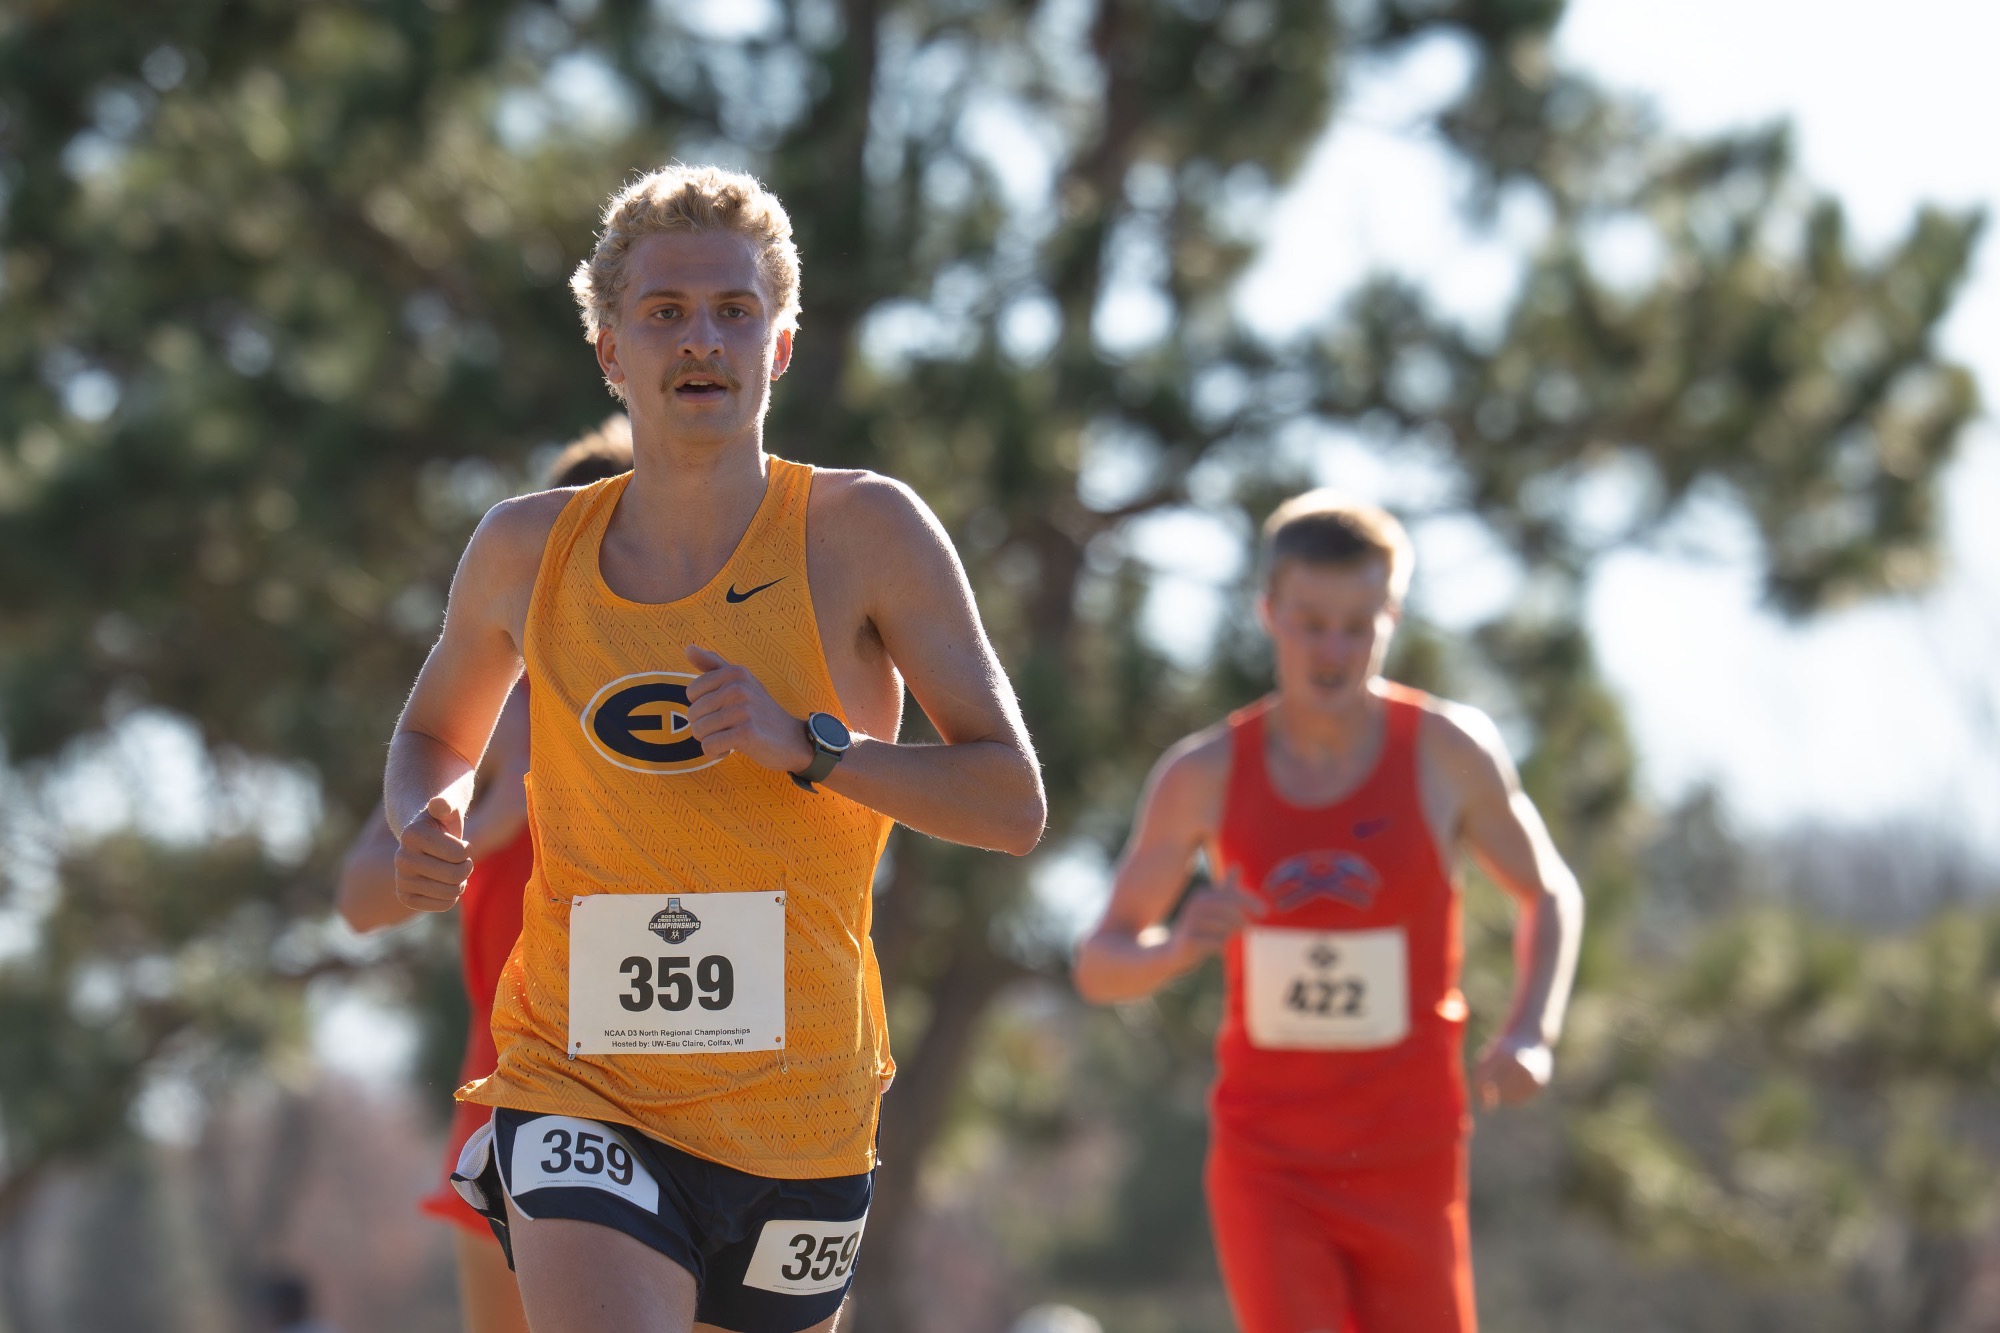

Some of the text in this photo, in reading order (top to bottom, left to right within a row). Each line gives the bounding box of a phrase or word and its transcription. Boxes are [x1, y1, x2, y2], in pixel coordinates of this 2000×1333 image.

[649, 921, 700, 930] CHAMPIONSHIPS
[619, 954, 734, 1012] 359
[1286, 978, 1369, 1017] 422
[604, 1027, 751, 1038] NCAA D3 North Regional Championships
[612, 1038, 744, 1049] Hosted by: UW-Eau Claire, Colfax, WI
[540, 1128, 634, 1186] 359
[781, 1231, 860, 1283] 359
